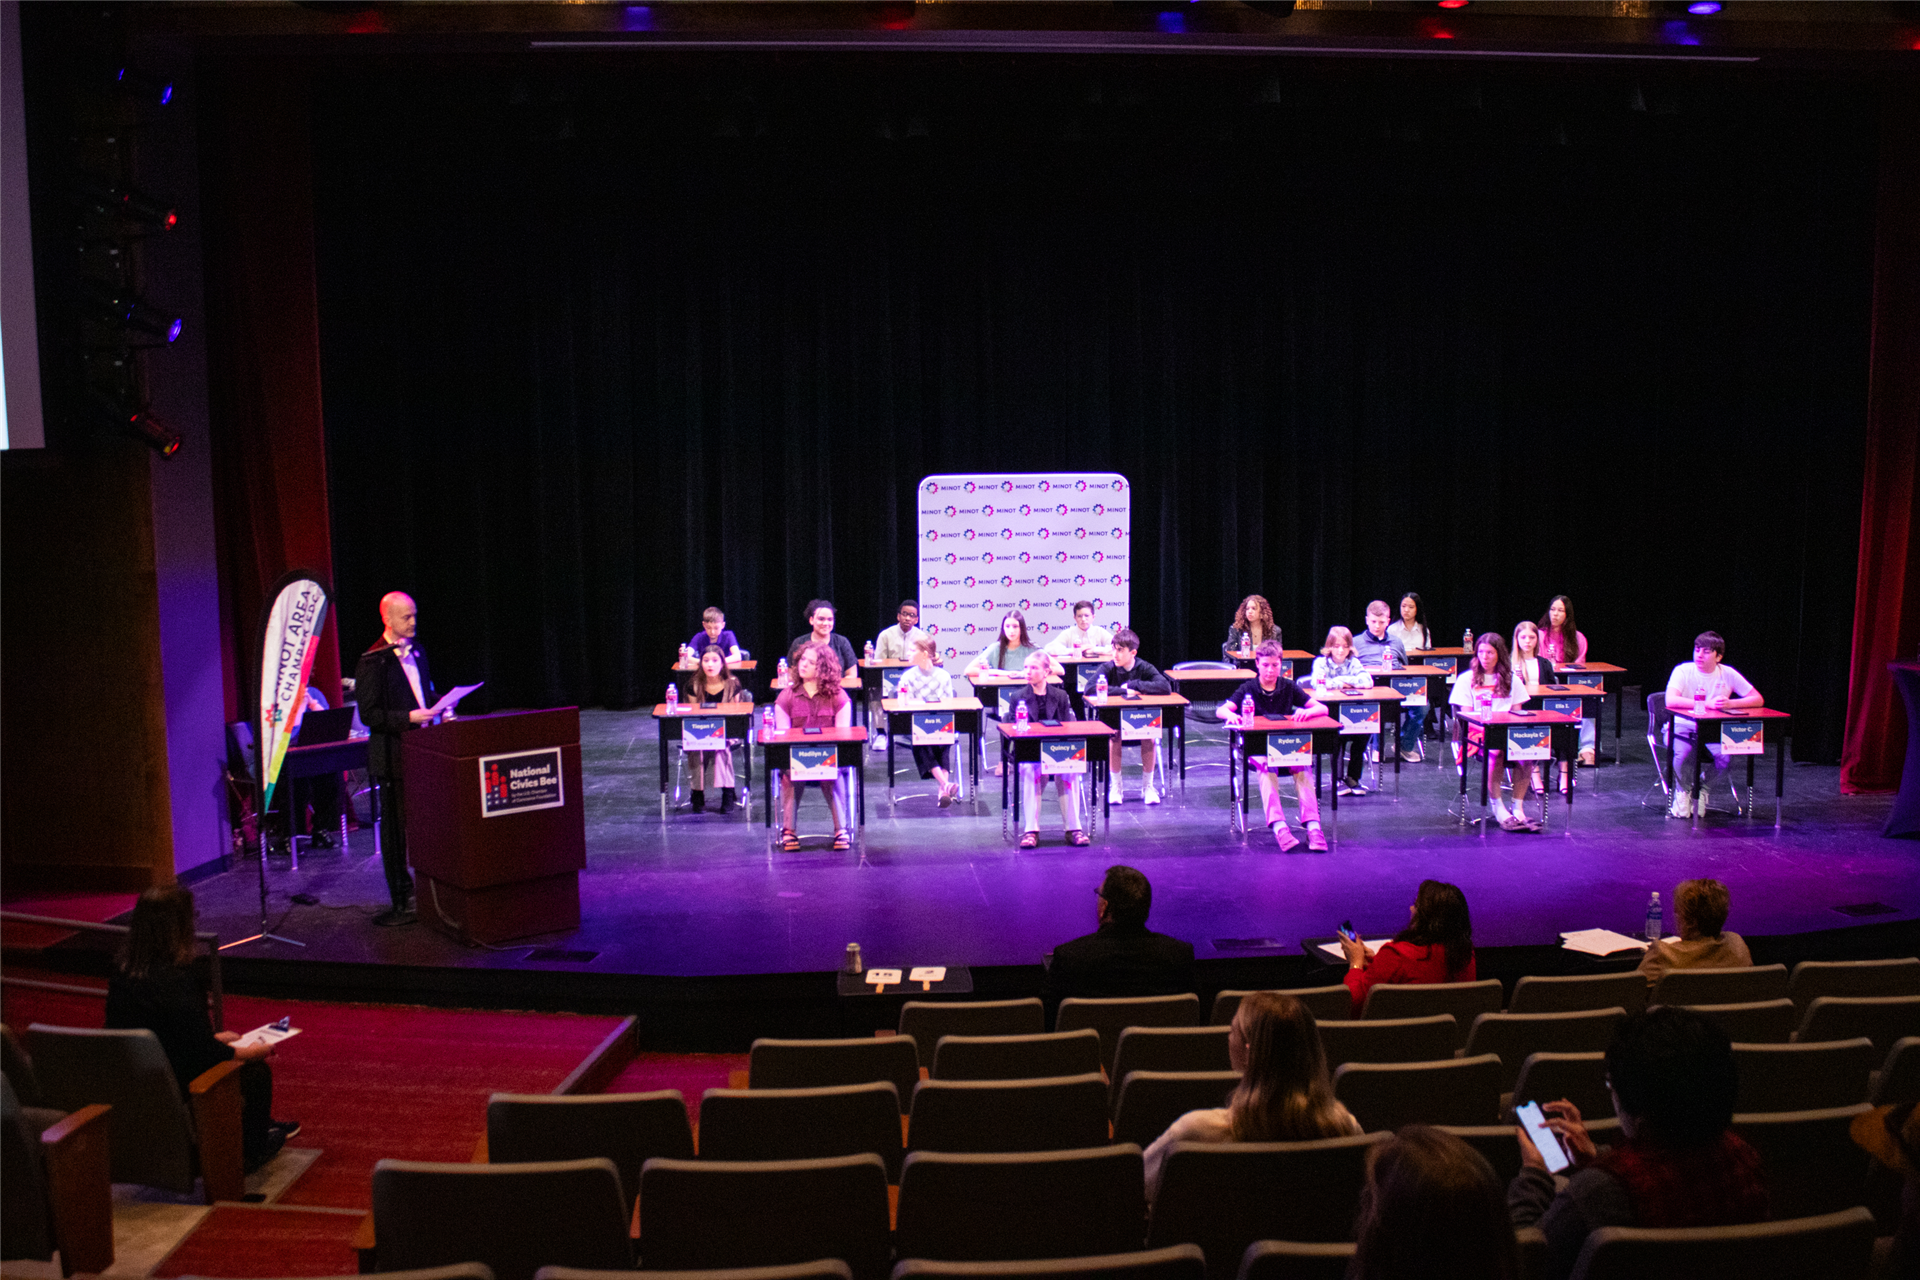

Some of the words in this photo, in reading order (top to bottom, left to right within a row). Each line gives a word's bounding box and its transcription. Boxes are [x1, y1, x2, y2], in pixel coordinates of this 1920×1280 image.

[288, 590, 310, 636] AREA
[281, 629, 310, 702] CHAMBER
[510, 764, 550, 778] National
[510, 778, 538, 790] Civics
[540, 776, 557, 786] Bee
